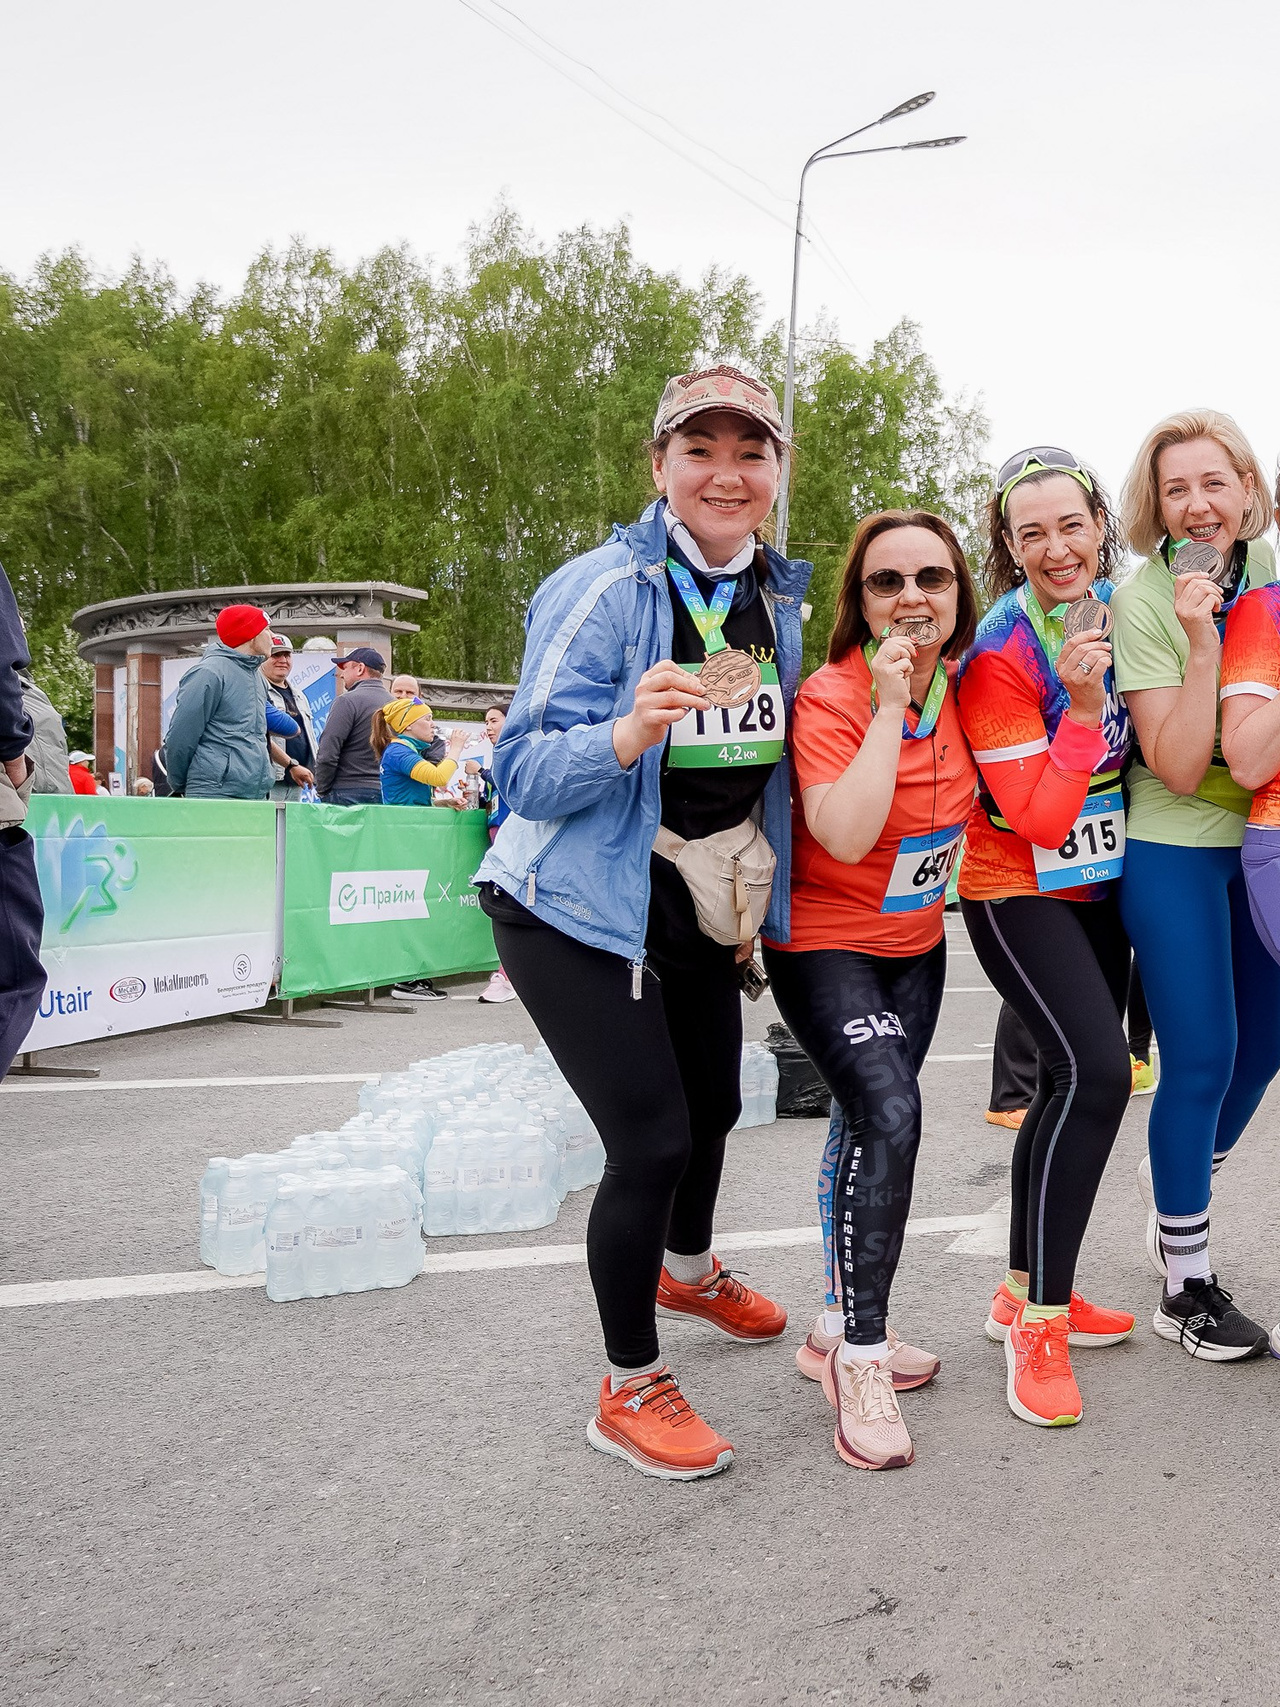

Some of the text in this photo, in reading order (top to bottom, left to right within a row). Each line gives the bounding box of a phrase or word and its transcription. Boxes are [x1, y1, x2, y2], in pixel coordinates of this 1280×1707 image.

[691, 693, 777, 736] 1128
[717, 745, 743, 763] 4,2
[1057, 818, 1117, 860] 815
[912, 841, 958, 887] 670
[363, 884, 415, 910] Прайм
[560, 896, 592, 916] Columbia
[38, 986, 93, 1019] Utair
